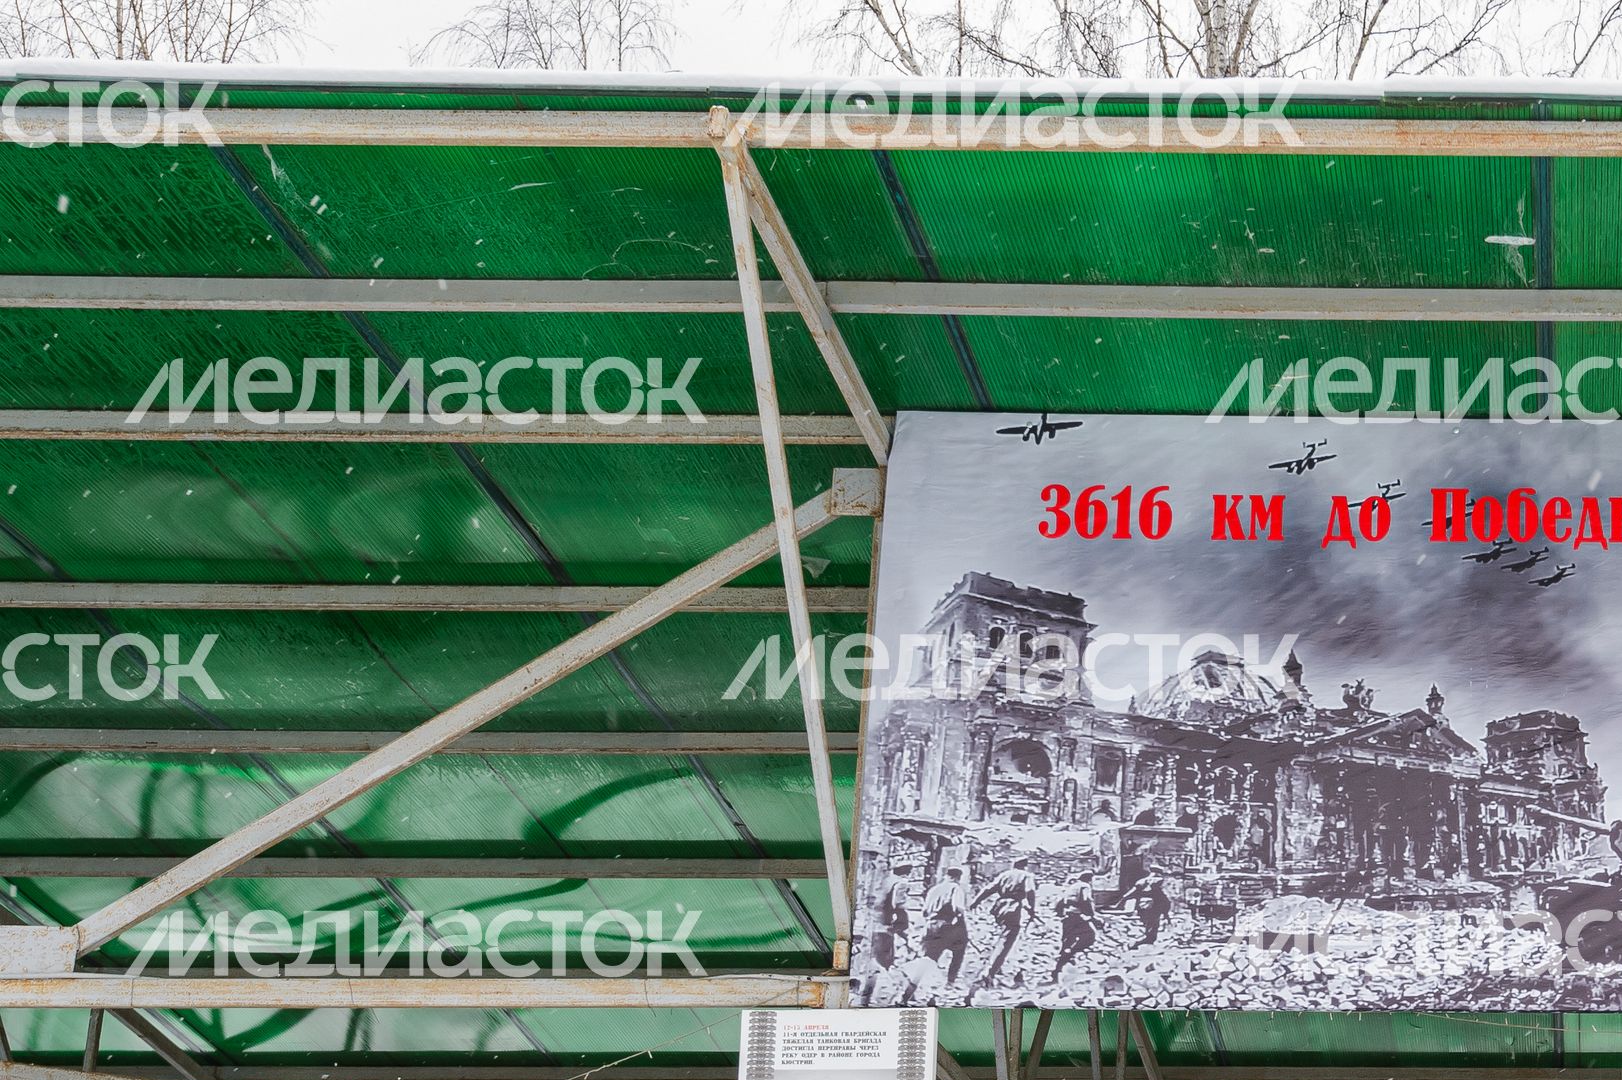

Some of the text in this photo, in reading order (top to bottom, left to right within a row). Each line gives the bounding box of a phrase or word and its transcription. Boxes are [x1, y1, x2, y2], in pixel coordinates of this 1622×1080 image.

[1038, 484, 1173, 540] 3616
[1211, 494, 1285, 541] км
[1321, 496, 1391, 549] до
